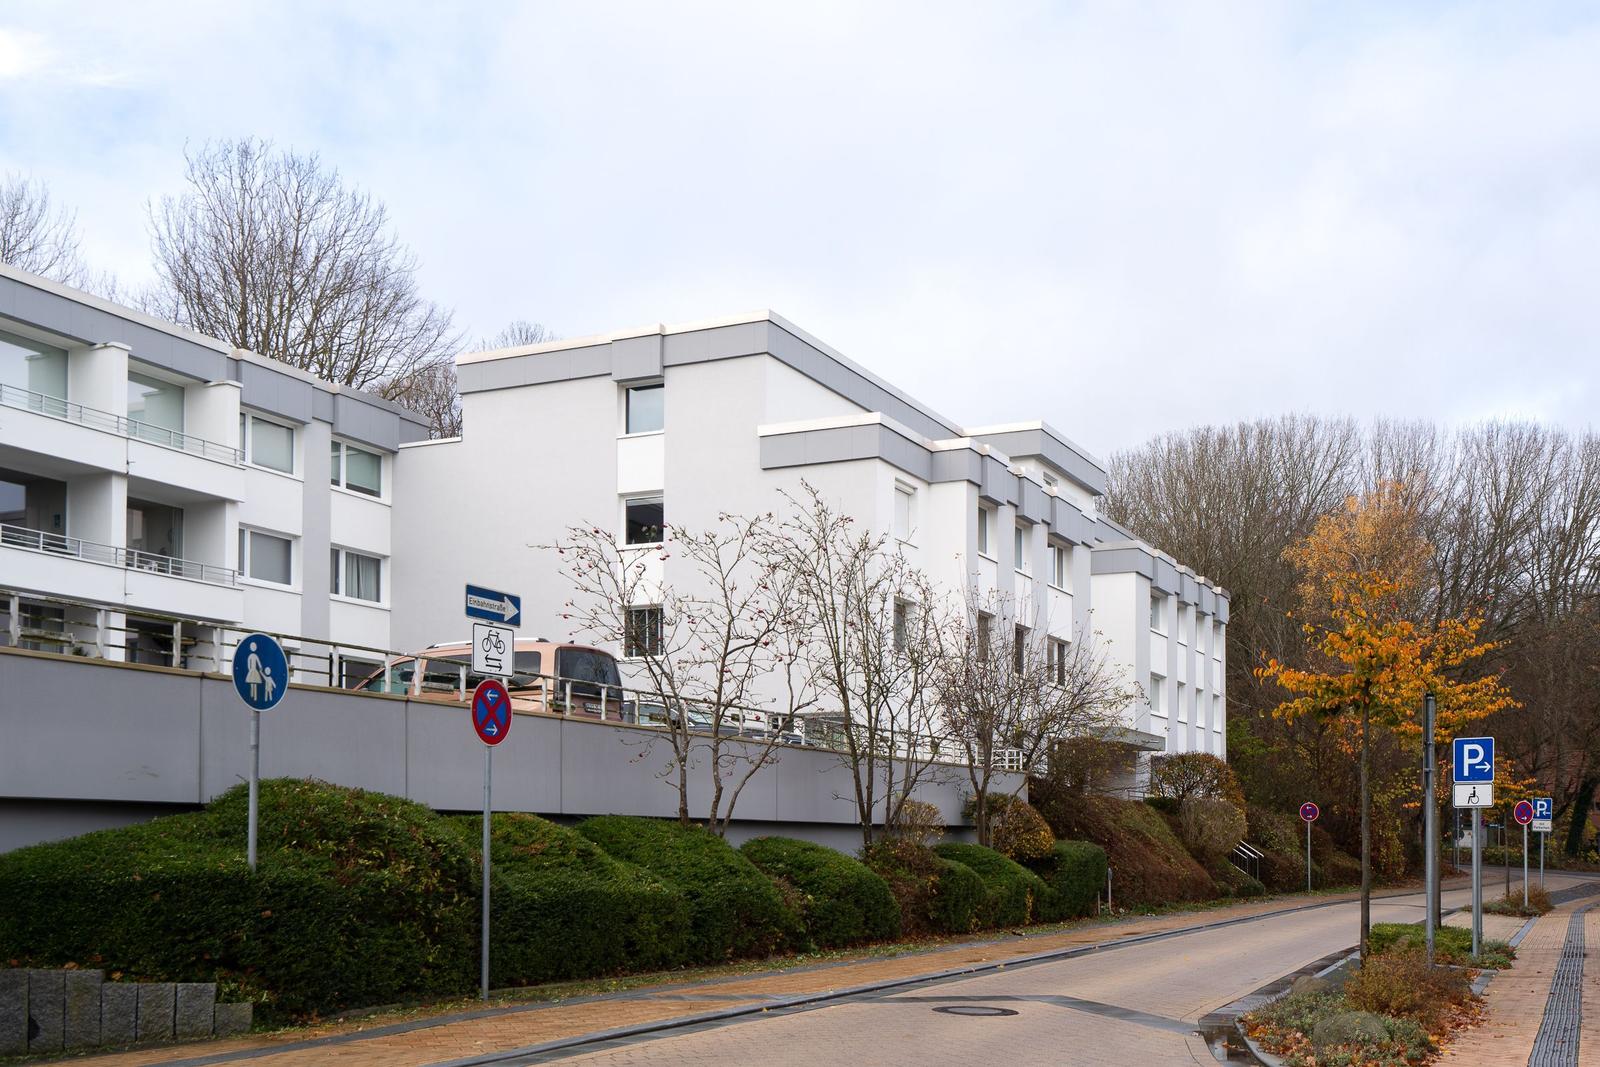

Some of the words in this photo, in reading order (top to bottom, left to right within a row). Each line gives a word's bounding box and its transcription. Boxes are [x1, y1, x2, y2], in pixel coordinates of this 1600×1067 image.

[469, 597, 506, 612] Einbahnstraße
[1464, 744, 1484, 776] P
[1537, 801, 1547, 816] P
